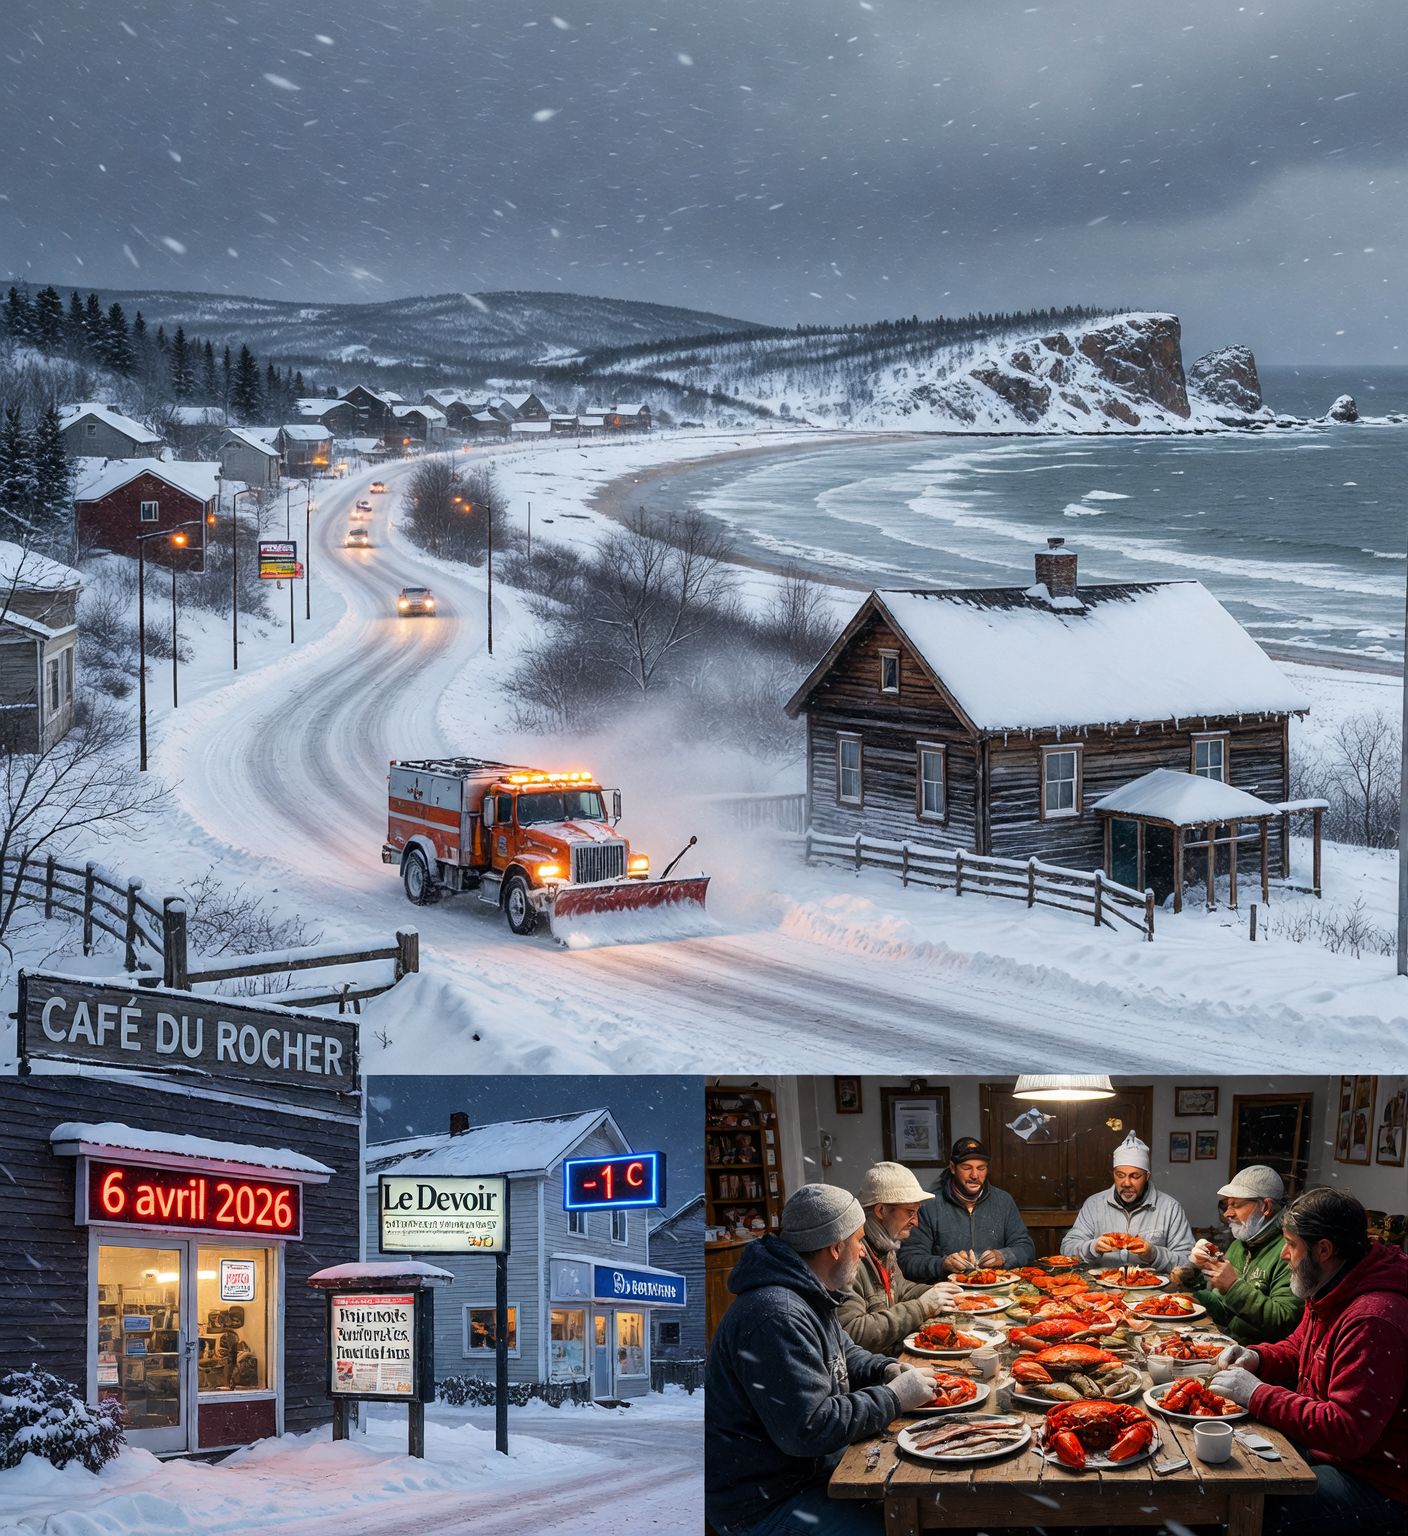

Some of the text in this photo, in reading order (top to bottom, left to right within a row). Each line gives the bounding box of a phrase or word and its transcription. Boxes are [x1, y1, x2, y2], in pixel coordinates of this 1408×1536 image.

[41, 997, 344, 1075] CAFÉ DU ROCHER
[627, 1162, 643, 1186] C
[102, 1172, 292, 1228] 6 avril 2026
[383, 1184, 498, 1211] Le Devoir
